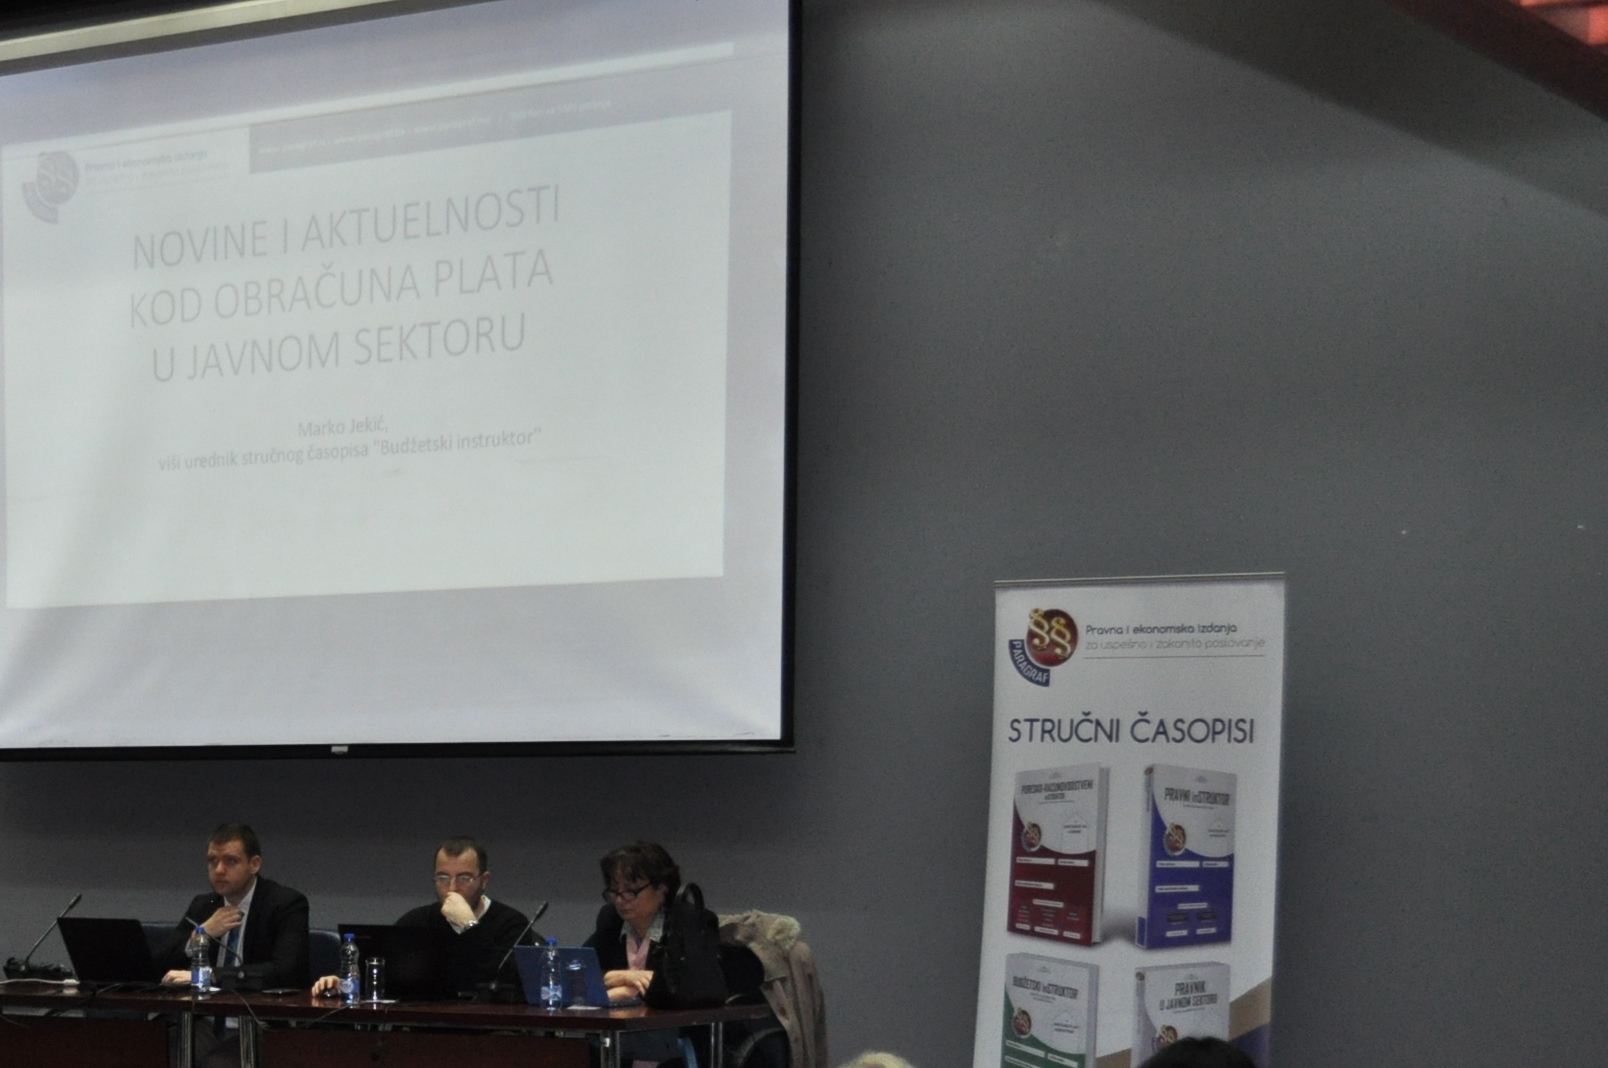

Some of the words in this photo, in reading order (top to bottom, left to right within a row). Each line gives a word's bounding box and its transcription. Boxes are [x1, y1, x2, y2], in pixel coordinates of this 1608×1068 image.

[132, 219, 268, 271] NOVINE
[281, 218, 290, 254] I
[301, 185, 561, 253] AKTUELNOSTI
[129, 286, 203, 330] KOD
[213, 262, 421, 321] OBRAČUNA
[434, 248, 554, 299] PLATA
[152, 346, 175, 383] U
[187, 330, 340, 381] JAVNOM
[353, 313, 527, 367] SEKTORU
[298, 420, 346, 438] Marko
[349, 415, 390, 436] Jekić,
[158, 455, 181, 472] viši
[185, 451, 238, 470] urednik
[241, 445, 304, 467] stručnog
[307, 441, 369, 464] časopisa
[1085, 624, 1124, 636] Pravna
[1132, 623, 1195, 635] ekonomska
[1197, 621, 1238, 636] izdanja
[1011, 640, 1049, 684] PARAGRAF
[1008, 711, 1120, 744] STRUČNI
[1130, 711, 1254, 744] ČASOPISI
[1164, 787, 1191, 803] PRAVNI
[1175, 980, 1206, 996] PRAVNIK
